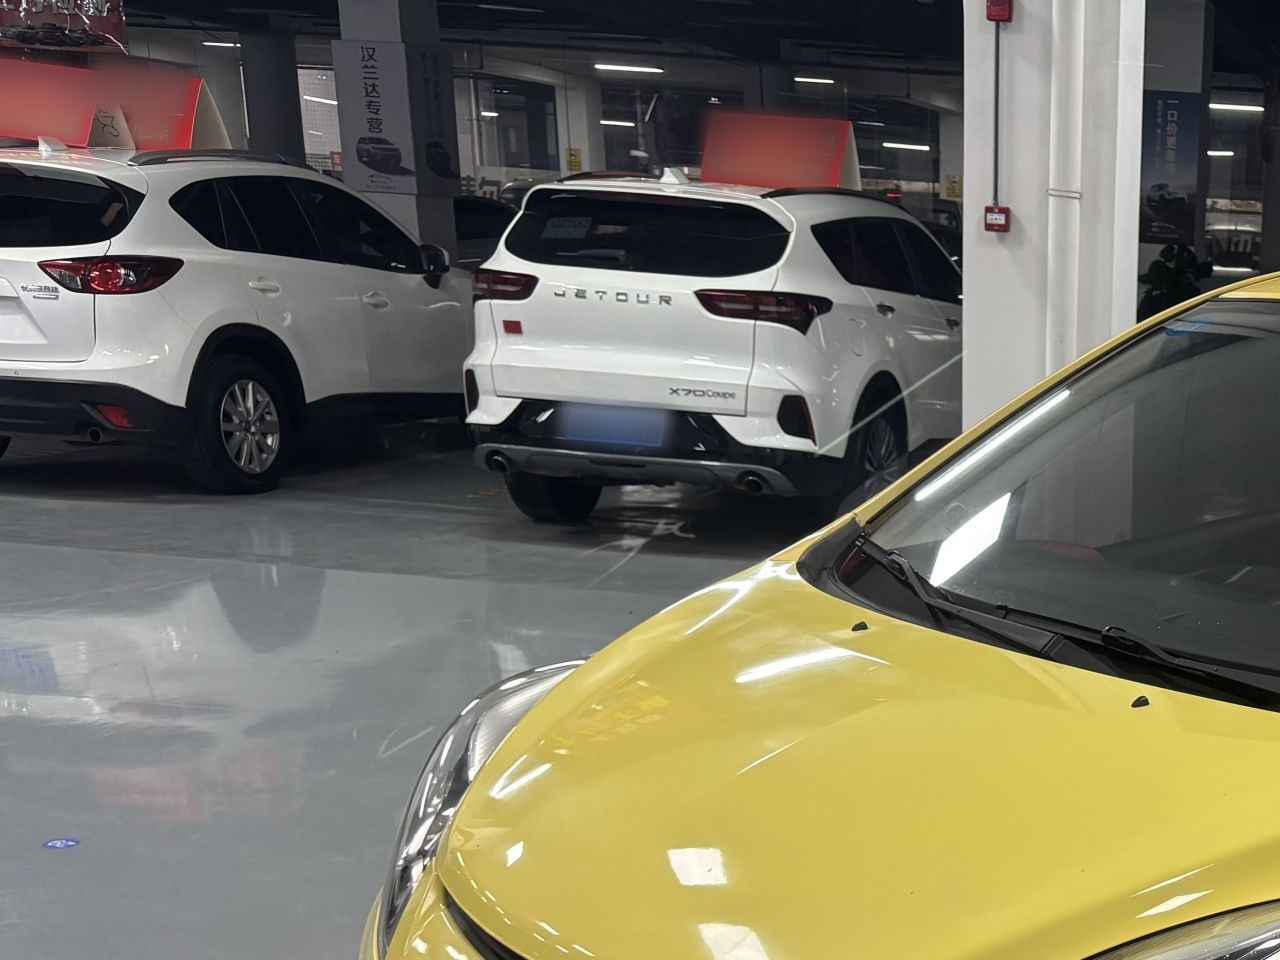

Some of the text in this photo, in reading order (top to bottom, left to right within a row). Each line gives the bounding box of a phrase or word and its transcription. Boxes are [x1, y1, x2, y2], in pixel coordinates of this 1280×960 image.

[361, 46, 383, 133] 汉兰达专营
[554, 289, 673, 306] JETOUR
